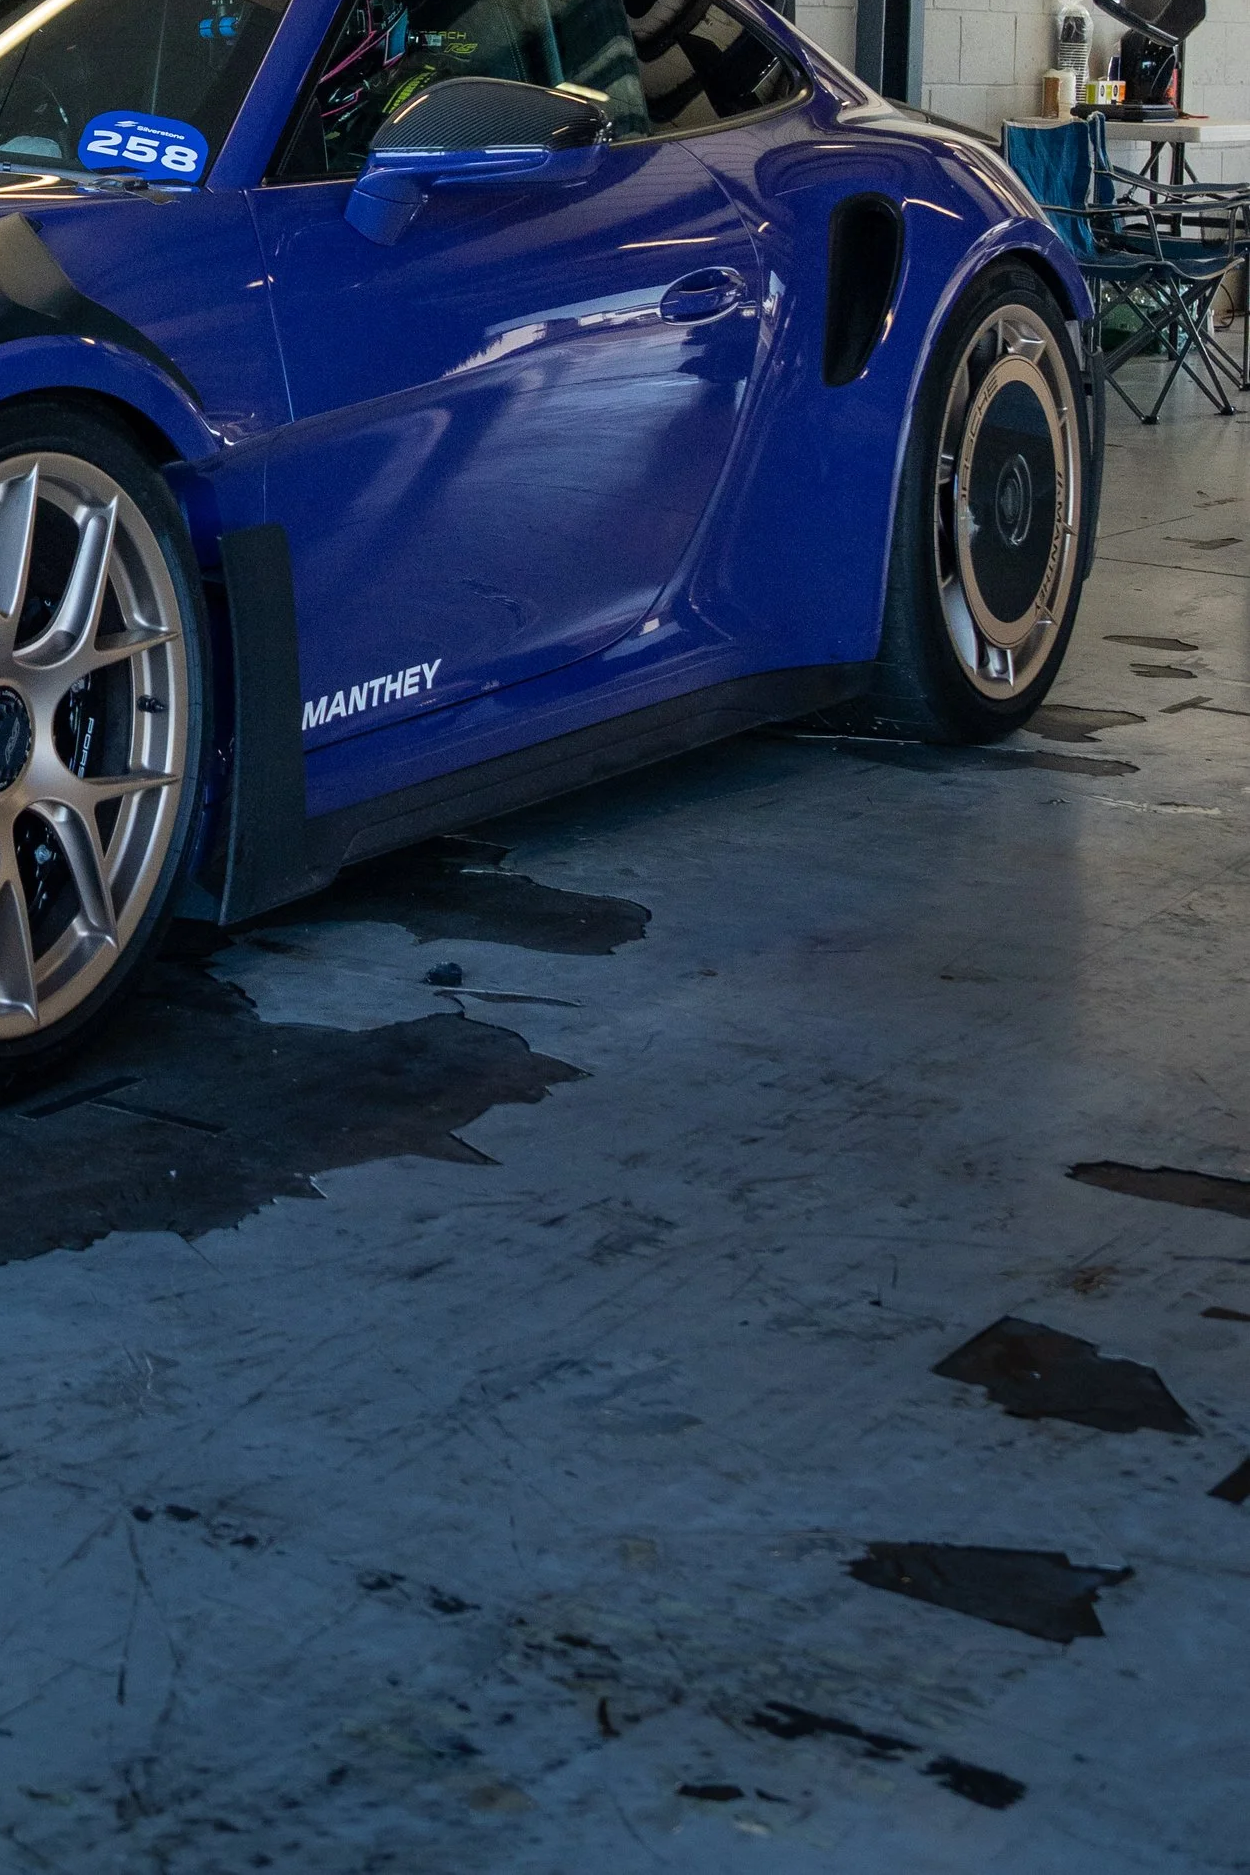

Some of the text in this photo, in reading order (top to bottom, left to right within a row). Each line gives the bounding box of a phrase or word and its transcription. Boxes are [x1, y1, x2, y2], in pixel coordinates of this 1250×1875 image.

[86, 129, 199, 173] 258
[136, 125, 185, 141] Silverstone
[301, 658, 442, 731] MANTHEY
[77, 717, 95, 779] PORS
